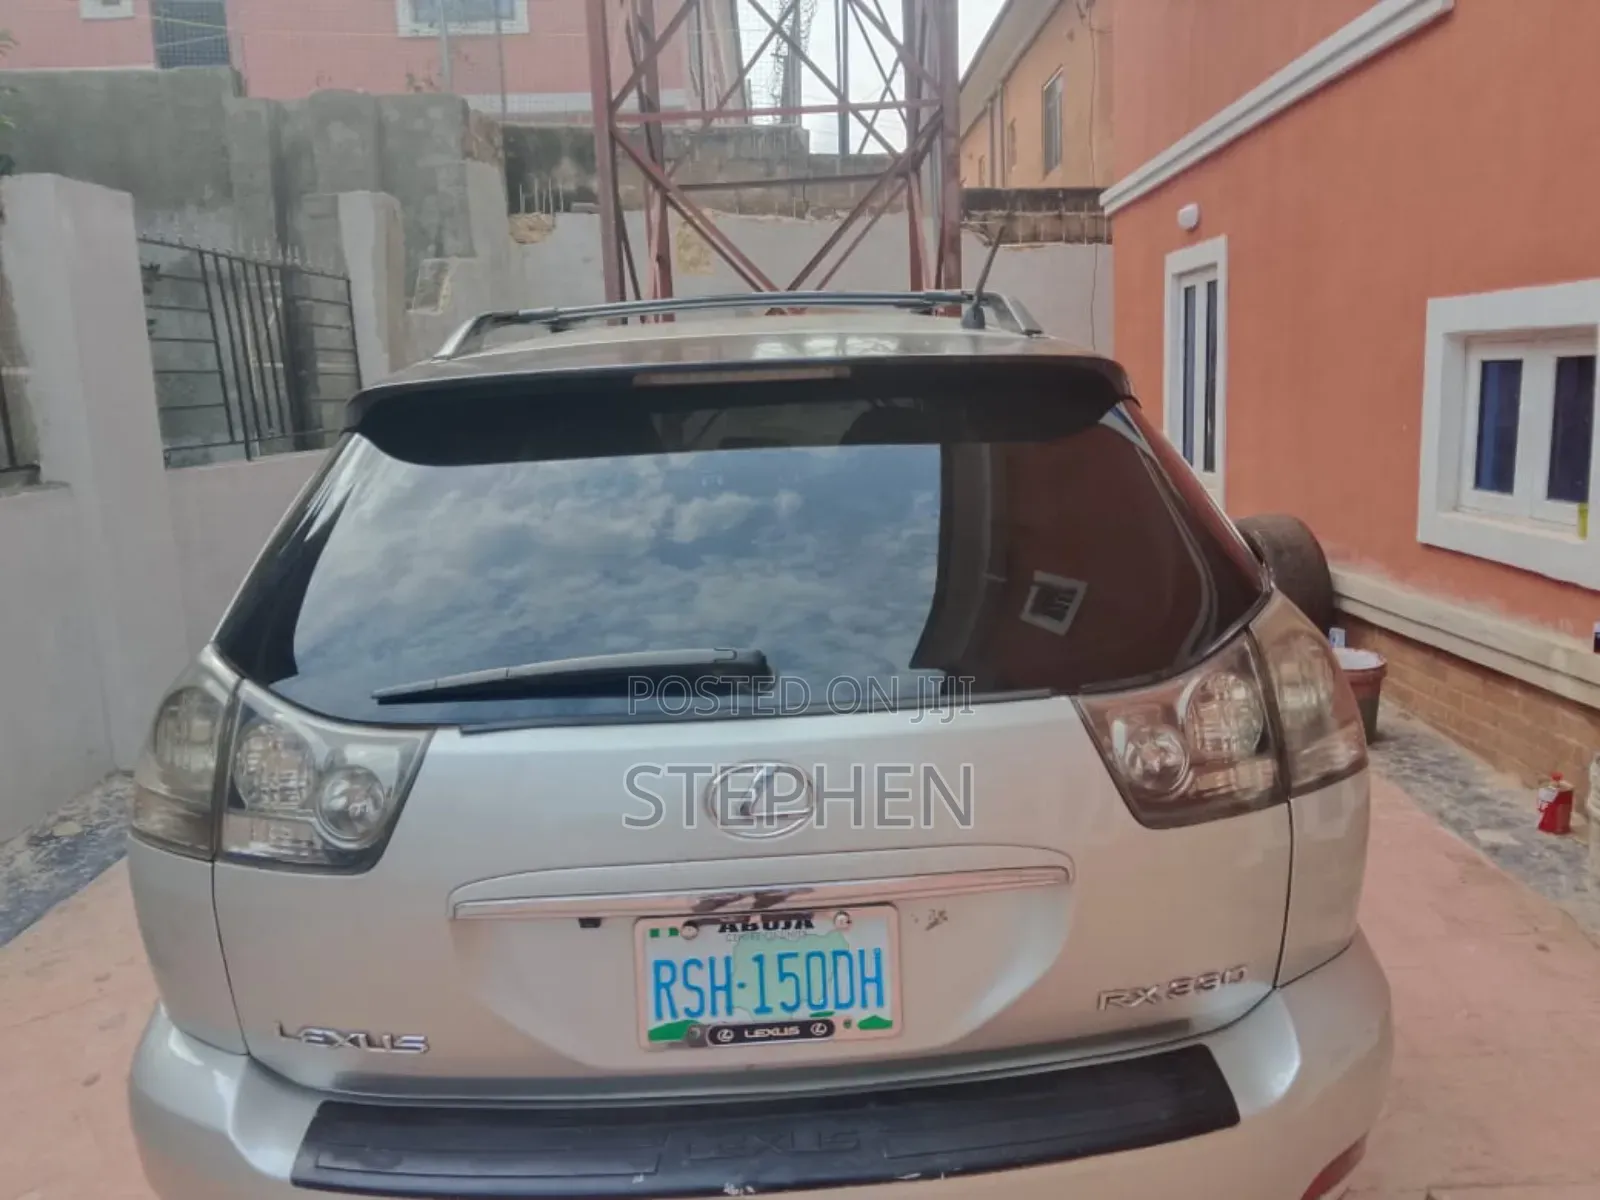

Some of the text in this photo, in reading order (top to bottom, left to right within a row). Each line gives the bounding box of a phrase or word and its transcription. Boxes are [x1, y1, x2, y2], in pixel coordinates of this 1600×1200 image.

[653, 947, 885, 1022] RSH-150DH
[274, 1018, 431, 1054] LEXUS
[743, 1026, 801, 1039] LEXUS
